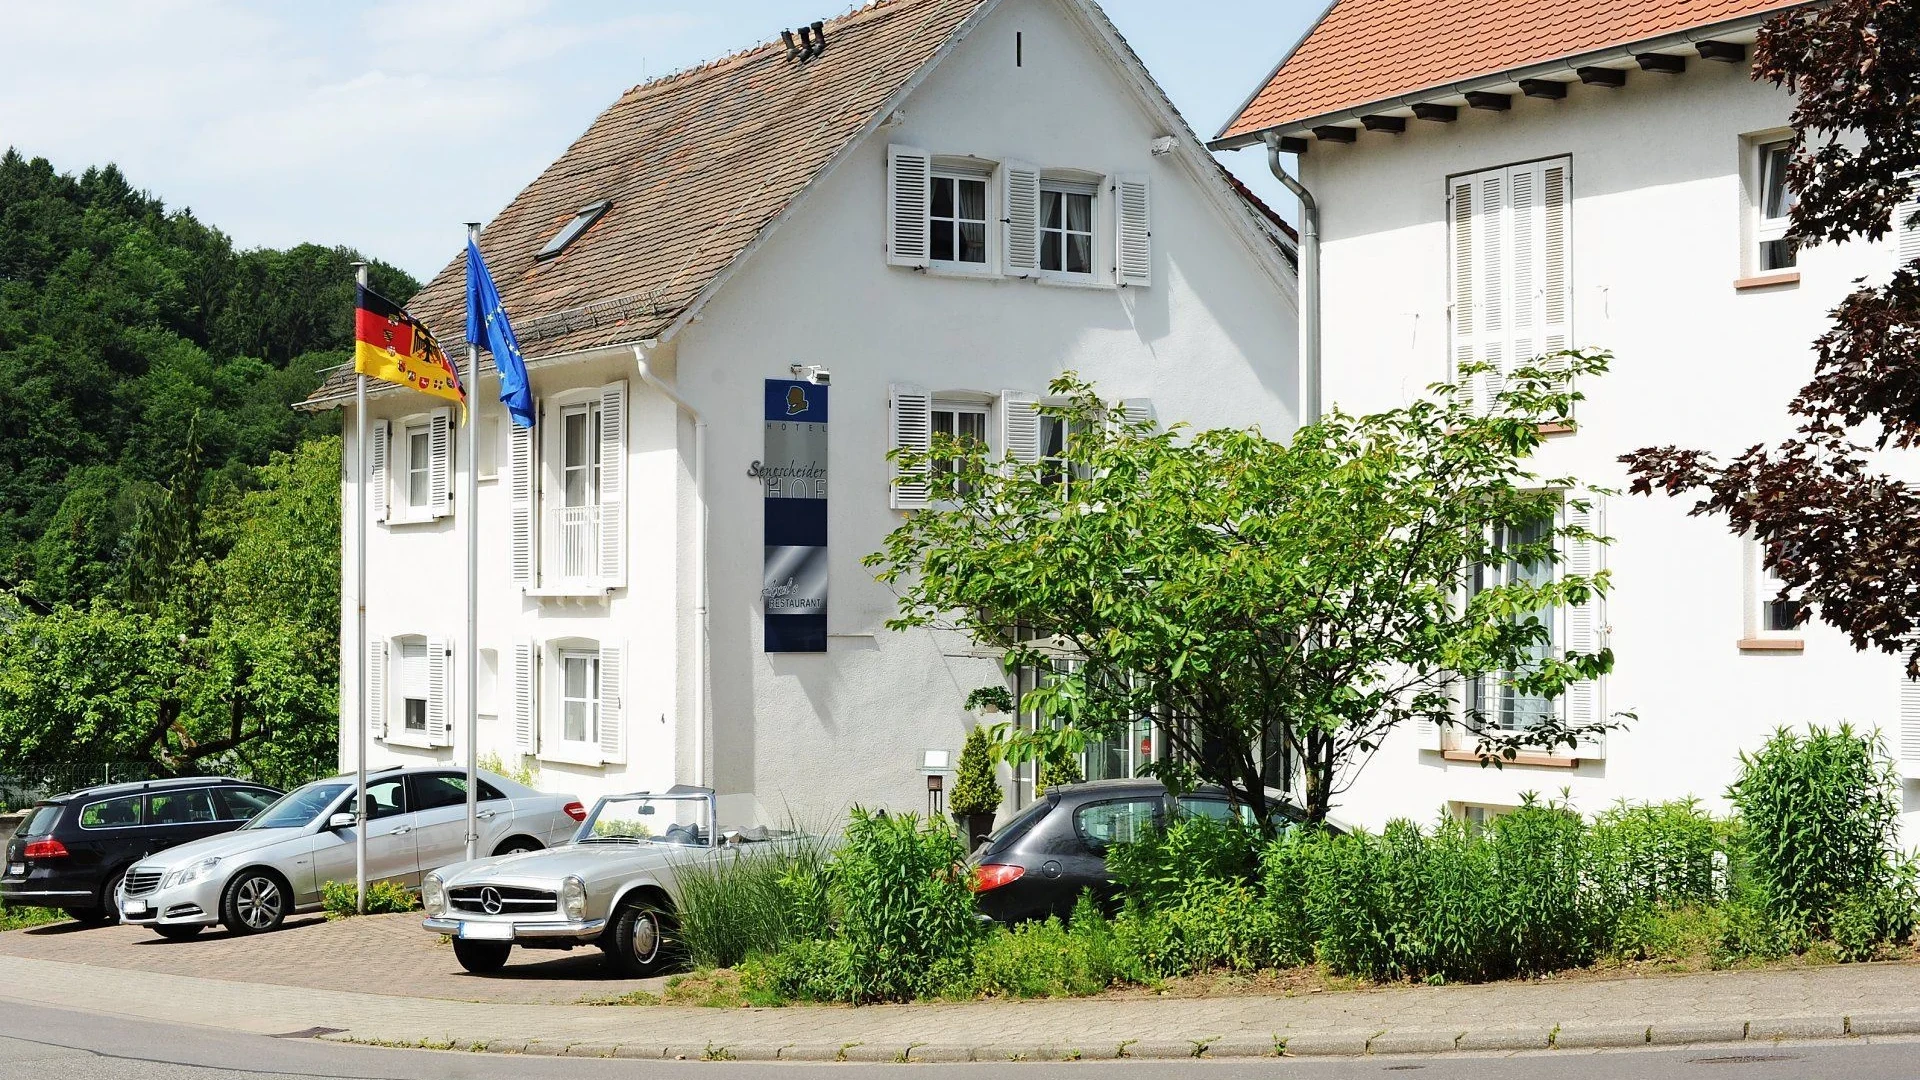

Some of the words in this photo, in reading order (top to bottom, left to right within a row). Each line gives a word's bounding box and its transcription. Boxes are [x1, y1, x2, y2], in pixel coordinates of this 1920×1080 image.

[766, 423, 827, 432] HOTEL
[768, 477, 827, 498] HOF
[768, 598, 821, 608] RESTAURANT
